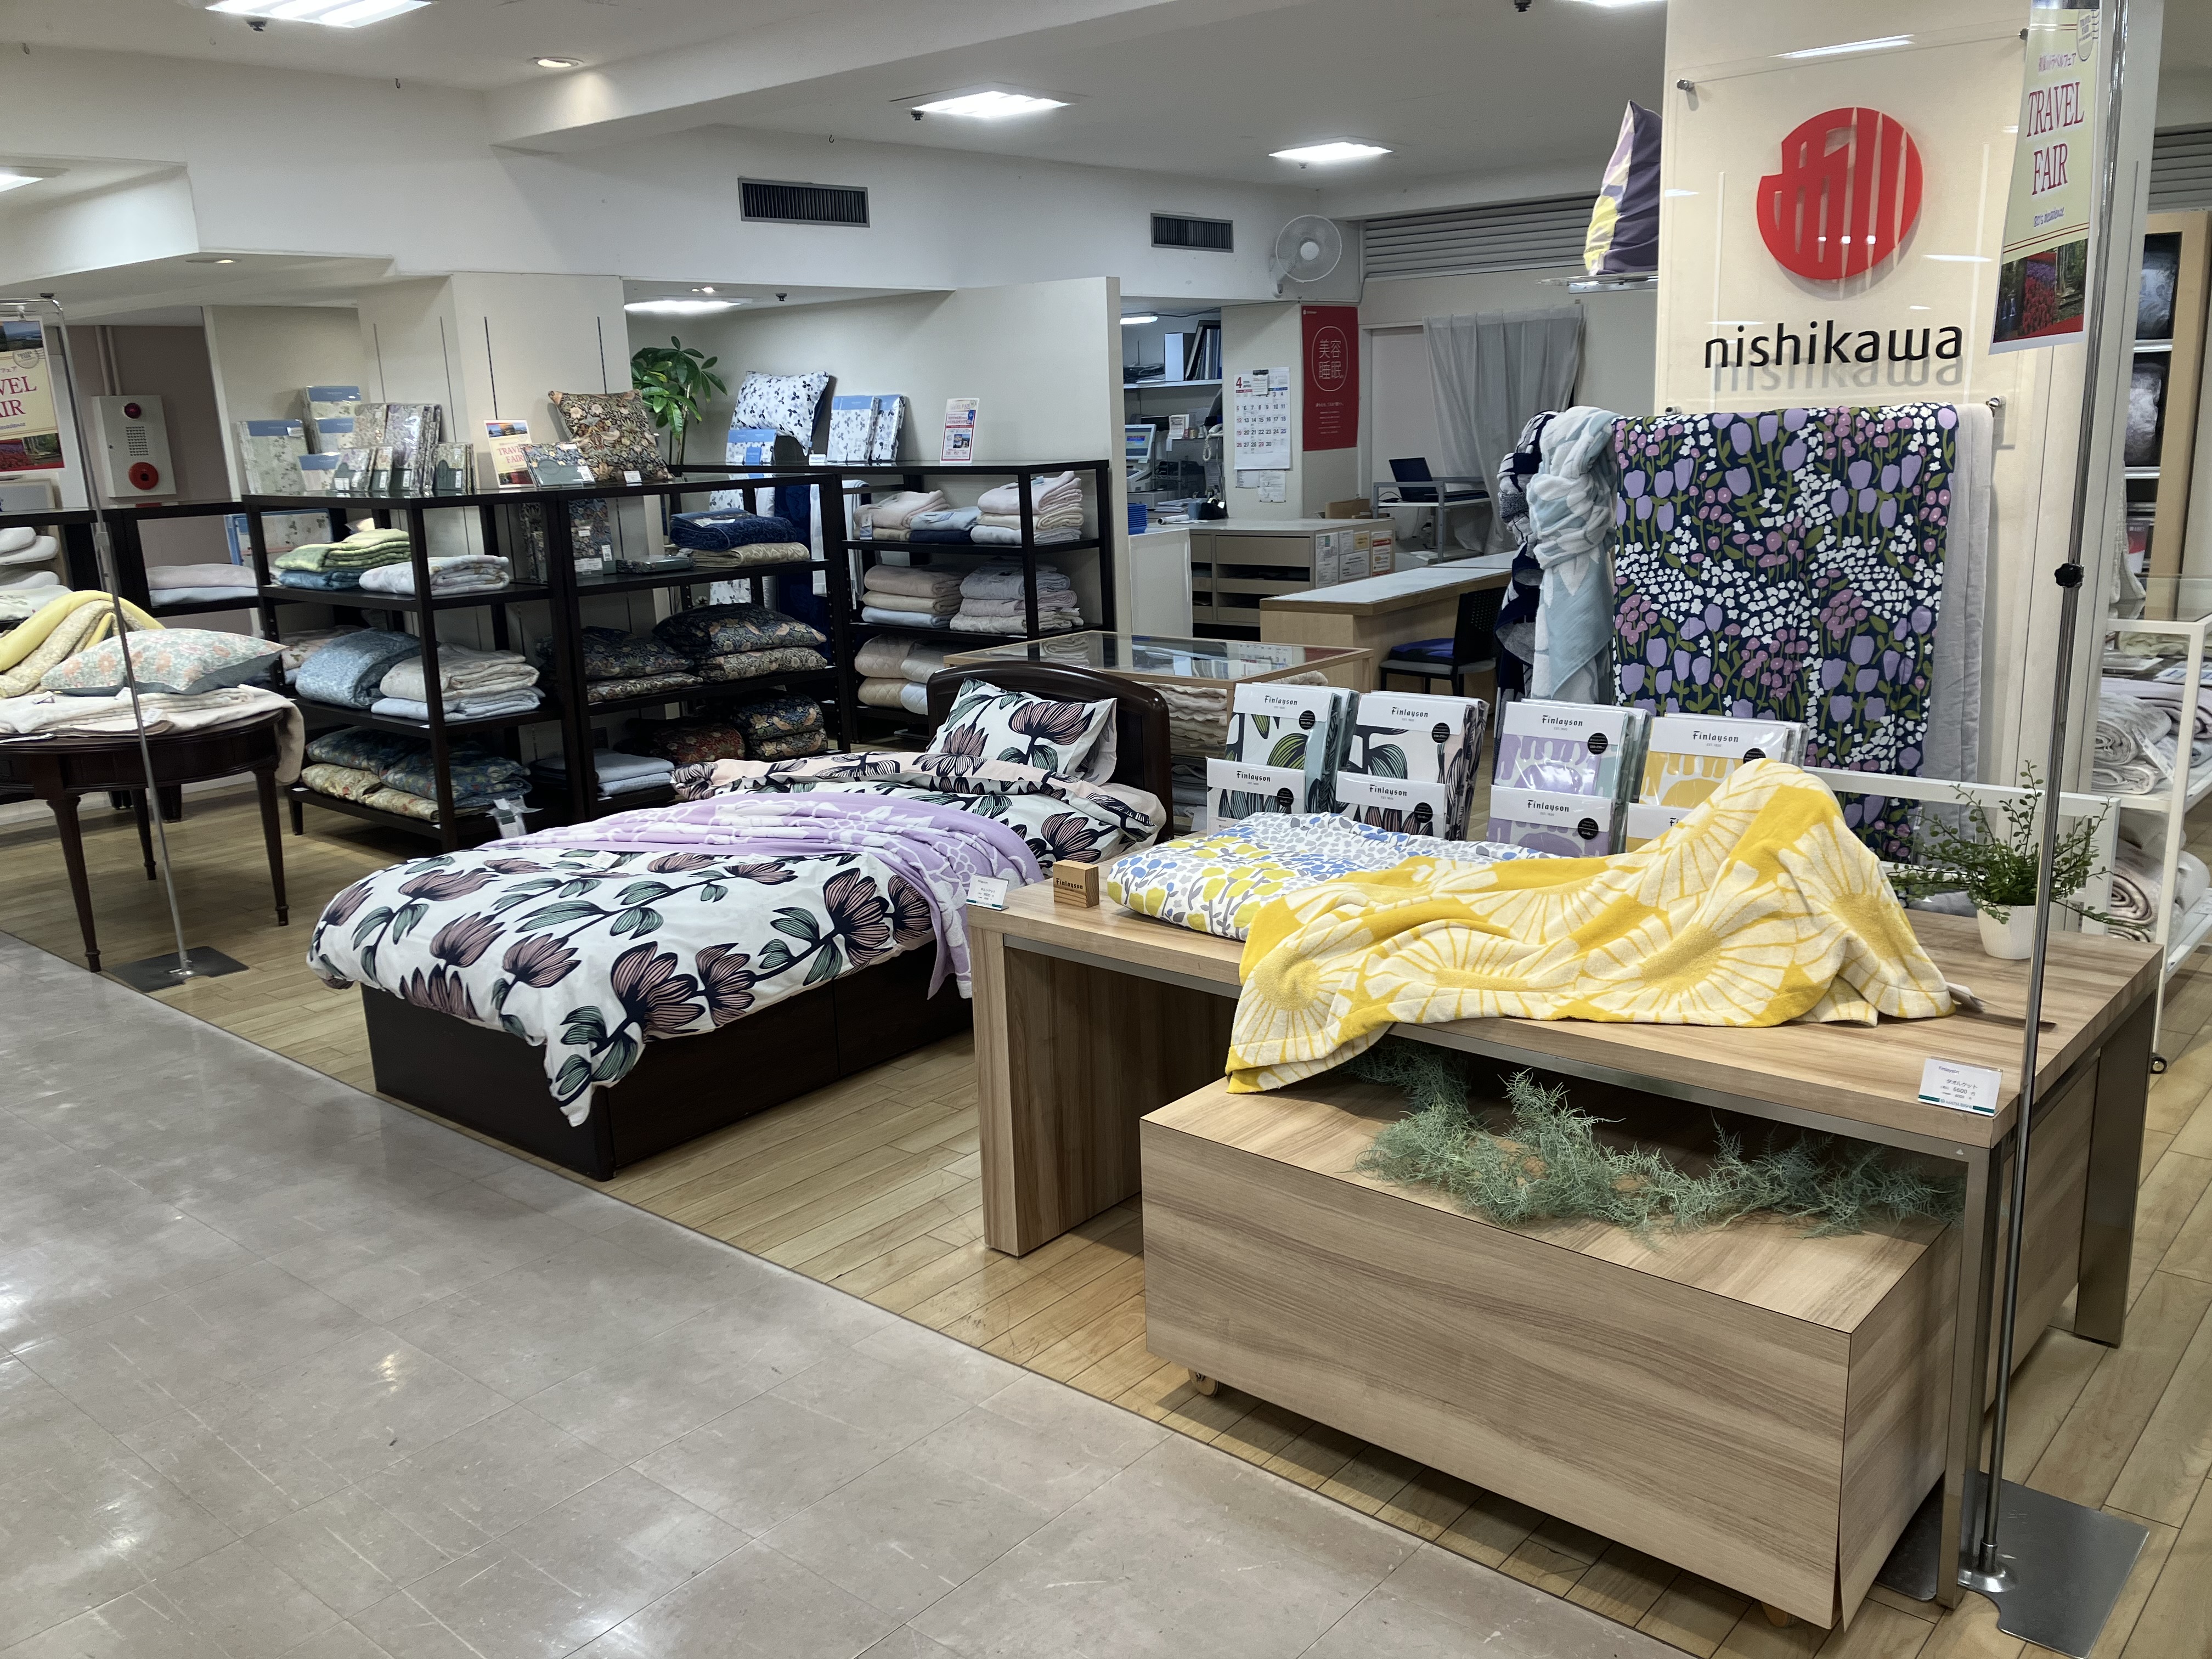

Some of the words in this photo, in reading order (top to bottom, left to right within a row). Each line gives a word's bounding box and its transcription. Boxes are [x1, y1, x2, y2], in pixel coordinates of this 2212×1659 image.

[2027, 82, 2084, 137] TRAVEL
[2032, 143, 2068, 195] FAIR
[1319, 339, 1341, 358] 美容
[1705, 320, 1962, 368] nishikawa
[1319, 360, 1342, 379] 睡眠
[1235, 377, 1243, 388] 4
[497, 445, 522, 455] TRAVE
[506, 455, 524, 464] FAIR
[1265, 695, 1297, 706] Finlayson
[1392, 707, 1428, 718] Finlayson
[1542, 715, 1583, 726] Finlayson
[1693, 731, 1739, 742] Finlayson
[1237, 770, 1271, 782] Finlayson
[1369, 784, 1407, 796] Finlayson
[1527, 799, 1569, 812] Finlayson
[1056, 877, 1083, 890] Finlayson
[1946, 1079, 1978, 1090] タオルケット
